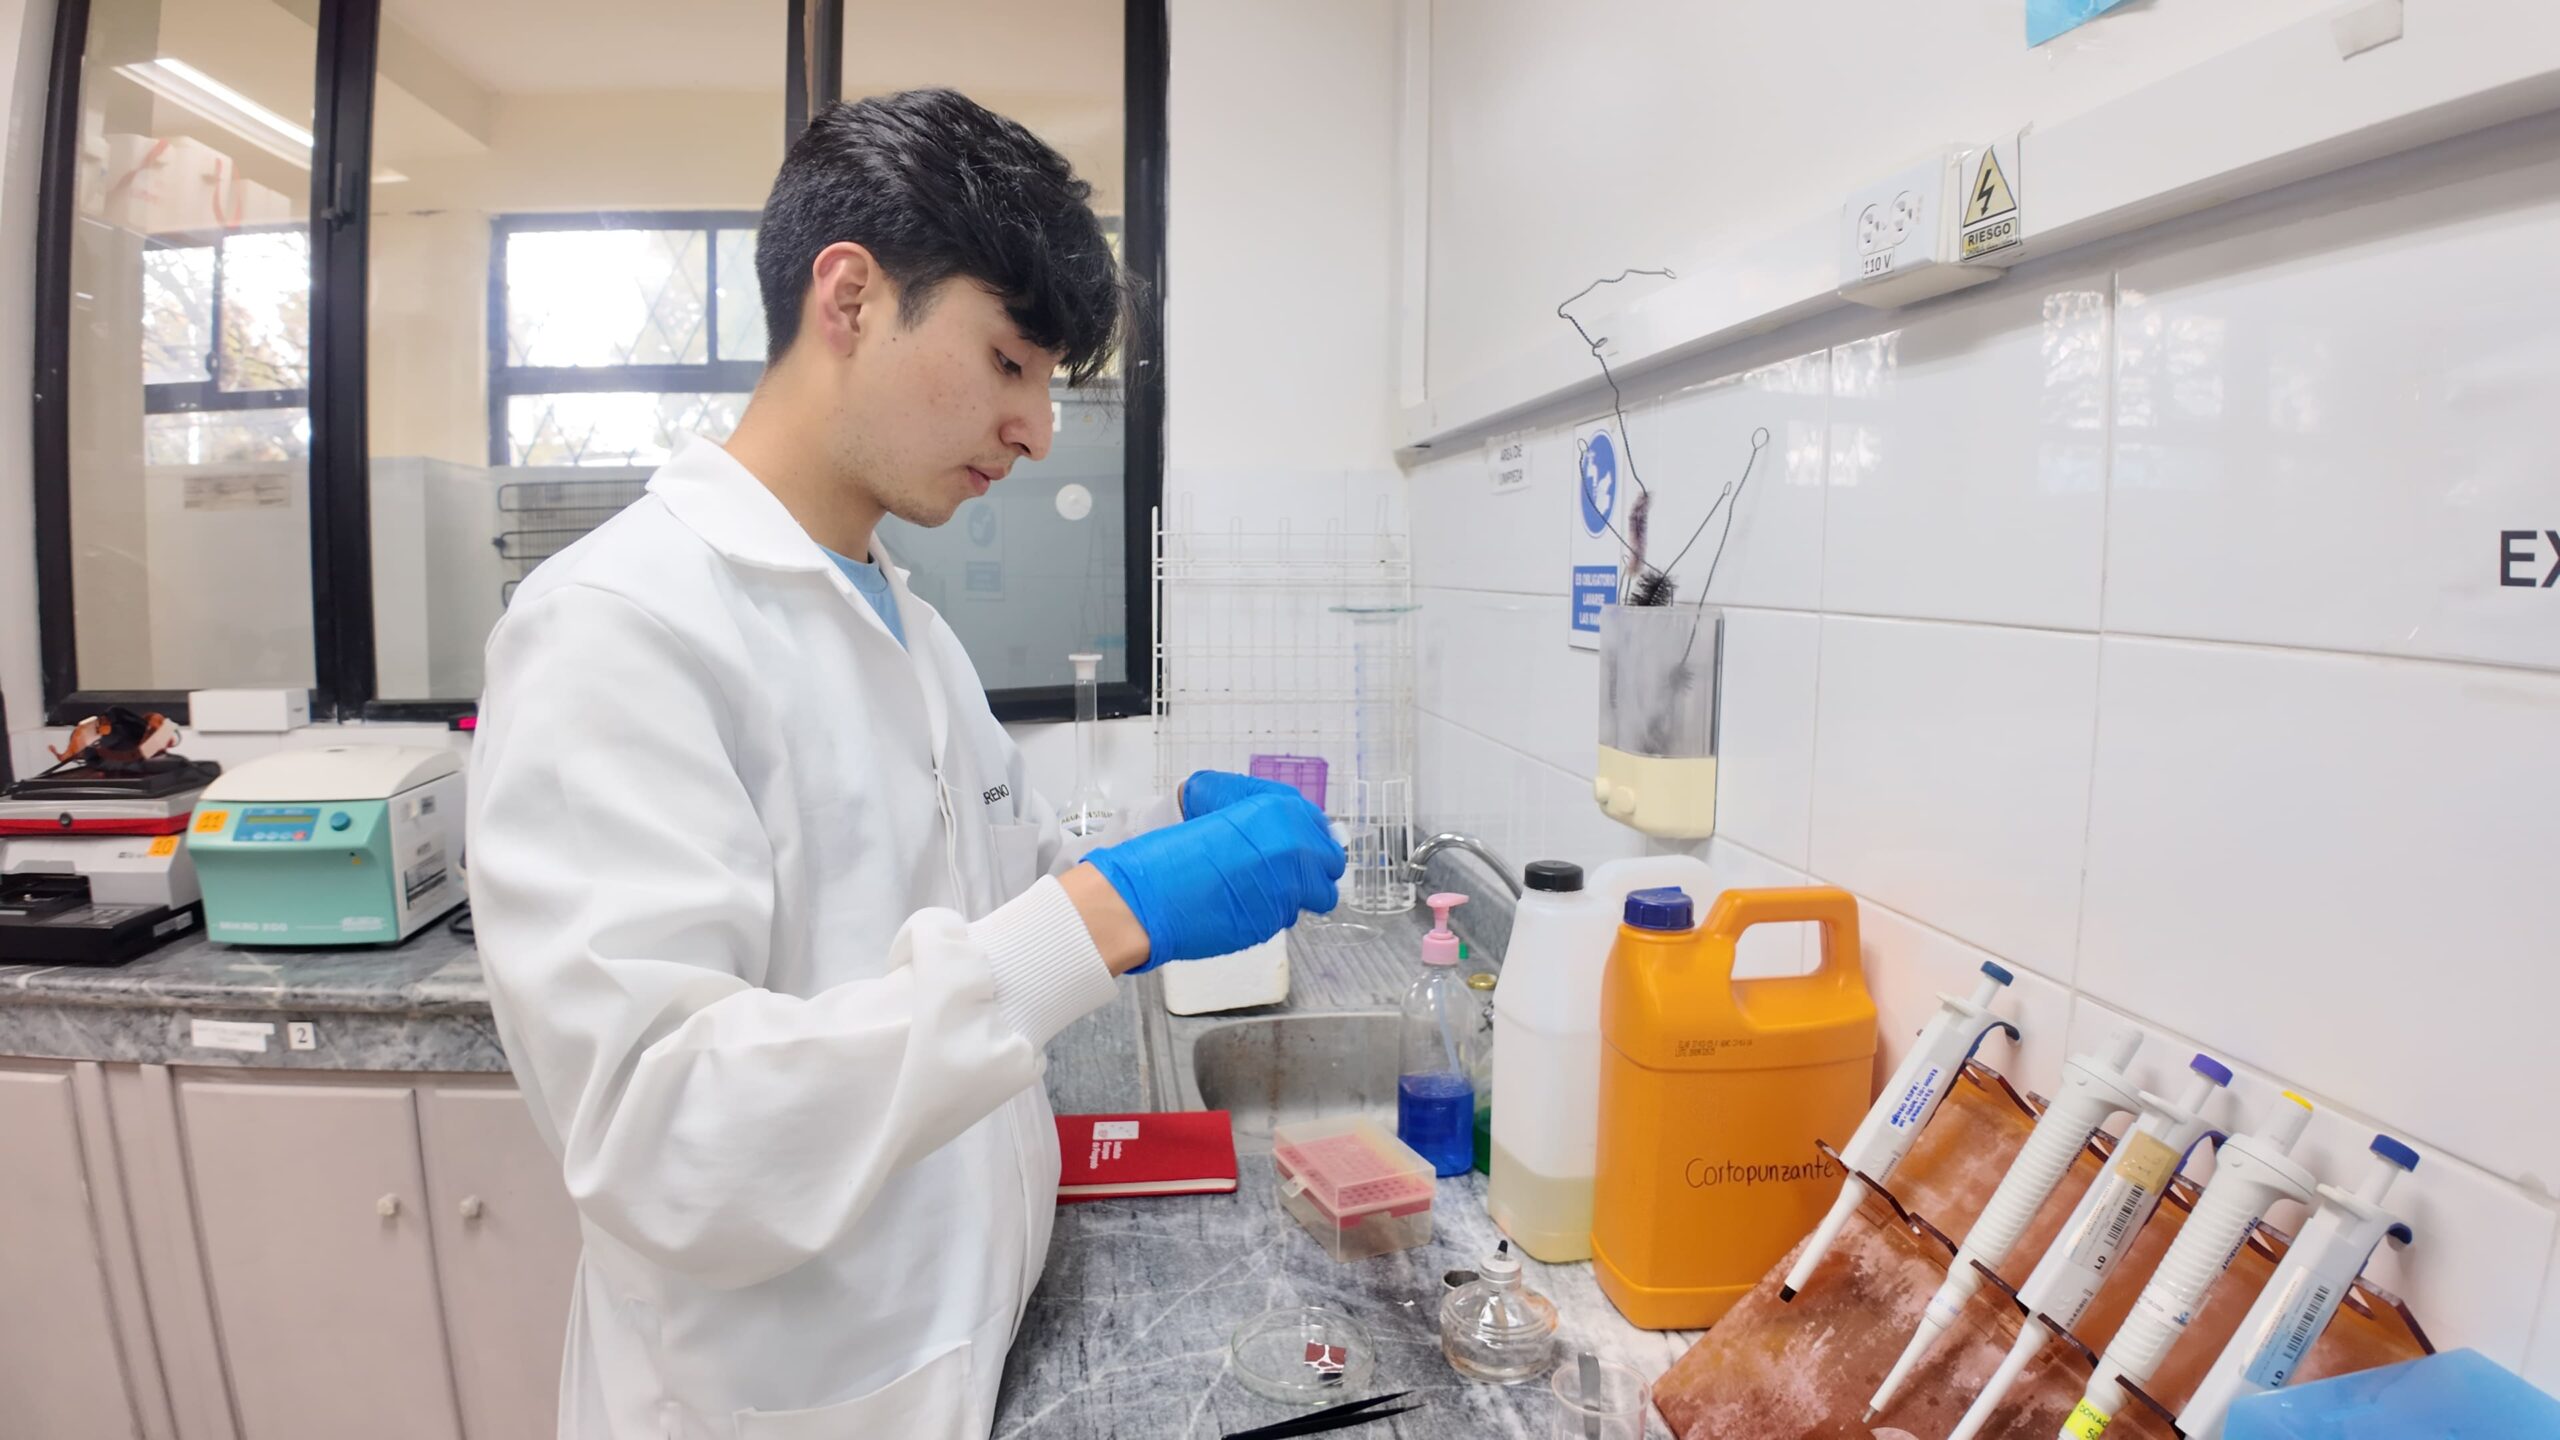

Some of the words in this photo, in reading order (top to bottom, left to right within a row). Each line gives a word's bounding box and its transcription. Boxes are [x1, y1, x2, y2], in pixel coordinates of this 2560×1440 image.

[1967, 222, 2011, 247] RIESGO
[1864, 257, 1881, 275] 110
[1884, 254, 1892, 269] V
[1582, 573, 1616, 587] OBLIGATORIO
[201, 813, 220, 829] 11
[154, 839, 173, 855] 10
[296, 1027, 308, 1044] 2
[1685, 1154, 1835, 1189] Cortopunzante
[2222, 1216, 2259, 1272] eppendorf
[2094, 1255, 2107, 1270] LD
[2270, 1370, 2284, 1387] LD
